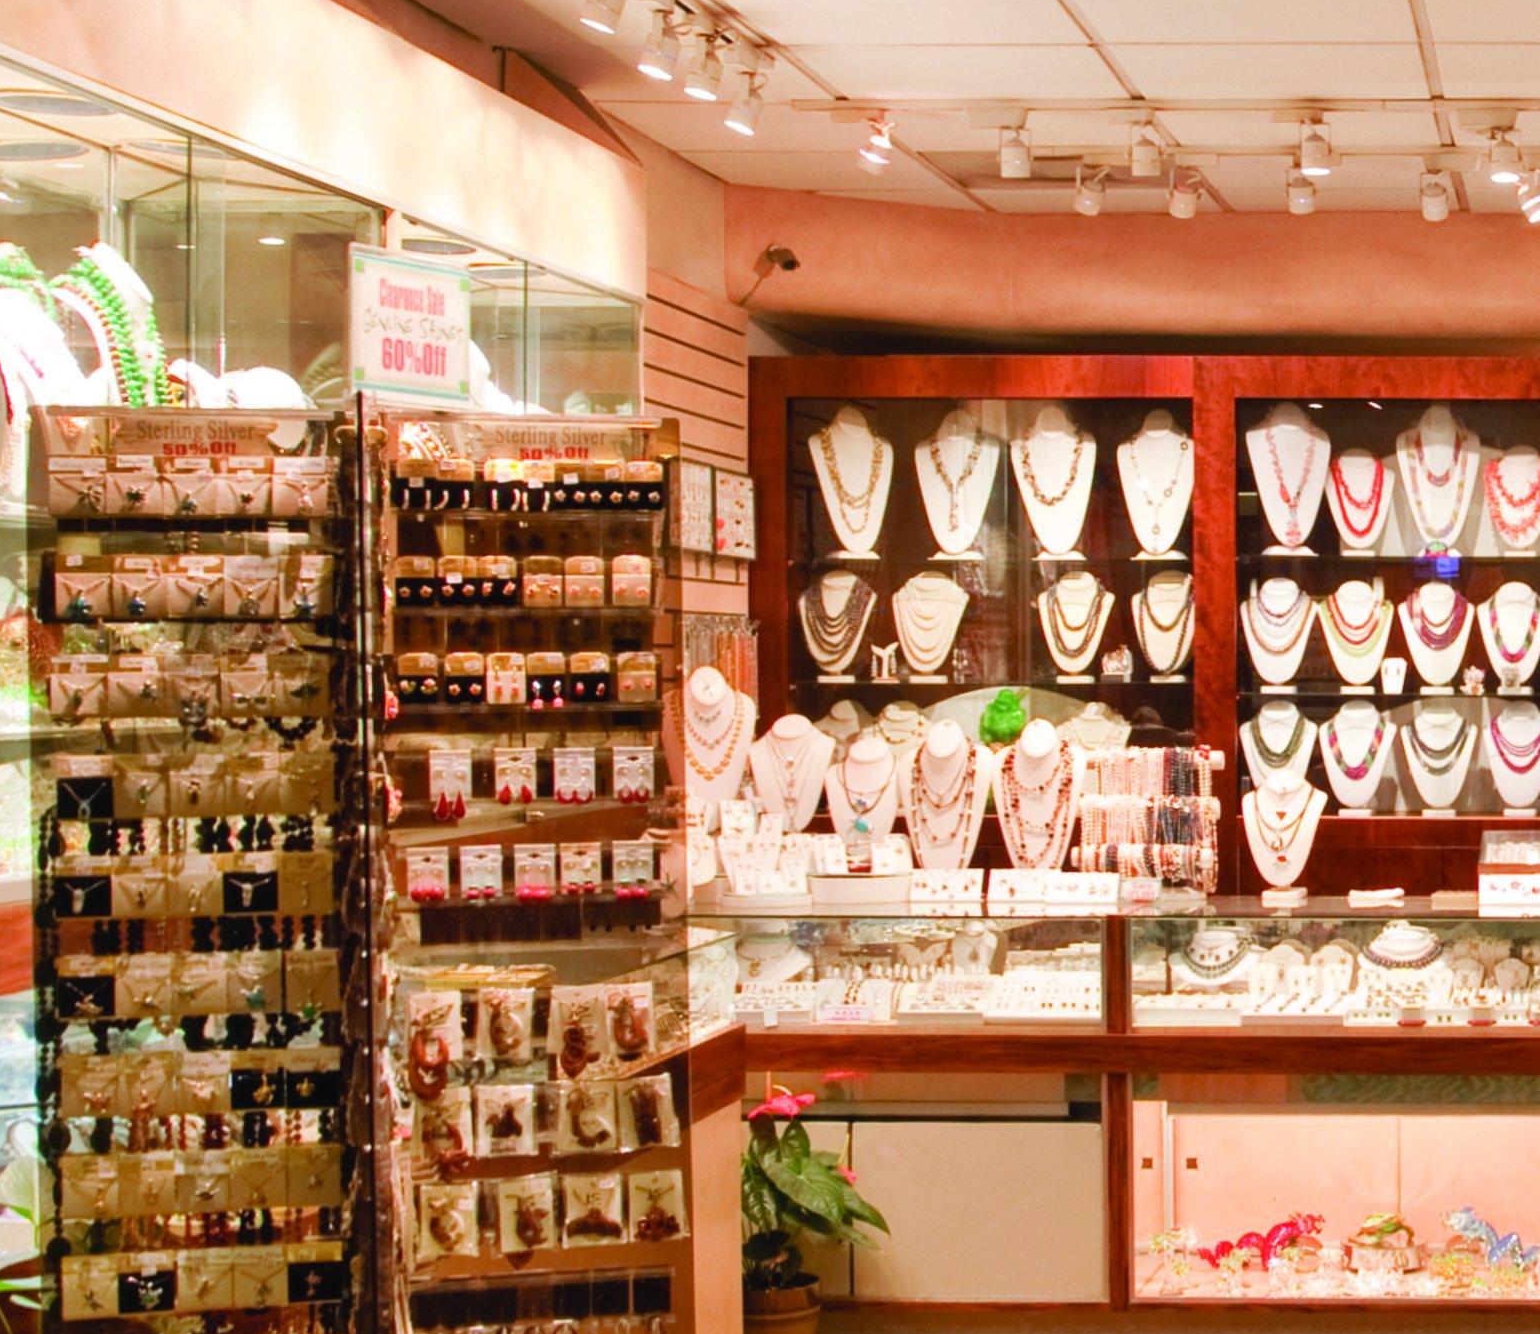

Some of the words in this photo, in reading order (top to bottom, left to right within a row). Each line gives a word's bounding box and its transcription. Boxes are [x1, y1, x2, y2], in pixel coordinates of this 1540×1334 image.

[136, 419, 203, 442] Sterling
[206, 419, 256, 440] Silver
[494, 426, 558, 447] Sterling
[561, 426, 607, 446] Silver
